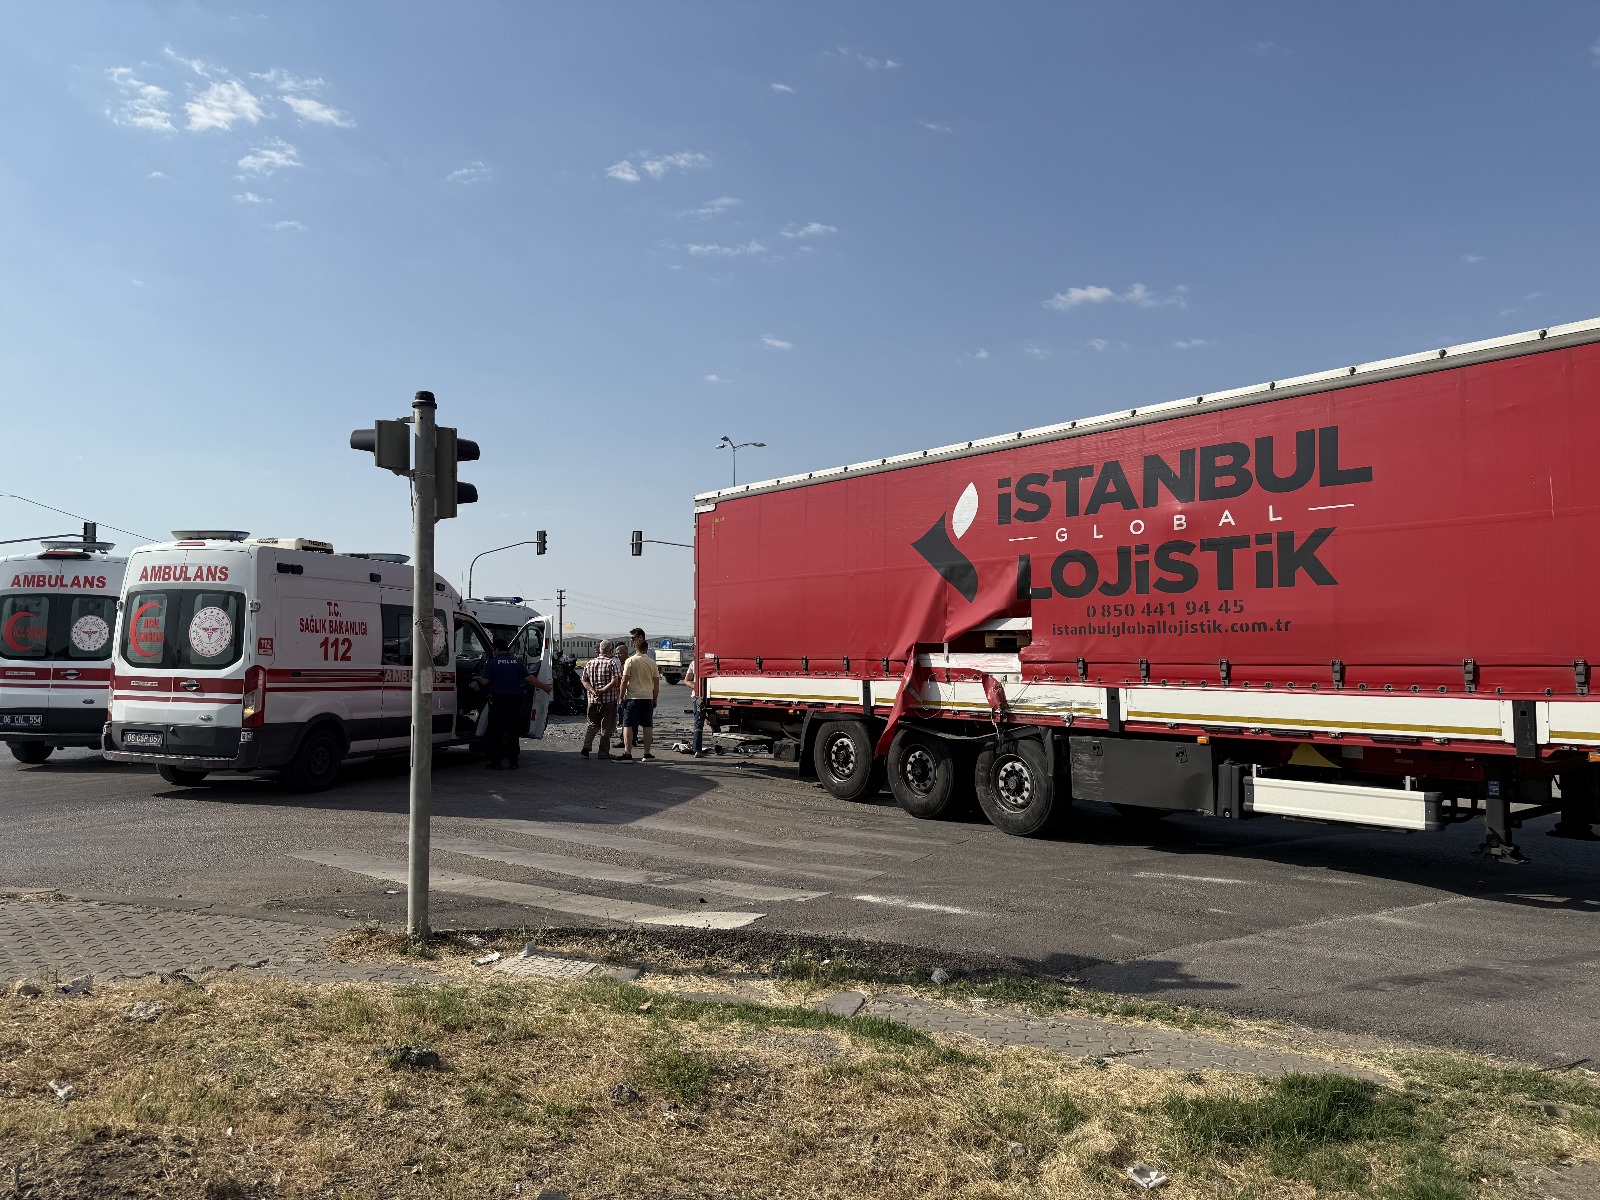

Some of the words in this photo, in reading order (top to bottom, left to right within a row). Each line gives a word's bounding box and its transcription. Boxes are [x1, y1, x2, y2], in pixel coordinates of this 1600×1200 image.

[1056, 505, 1282, 542] GLOBAL
[10, 574, 107, 589] AMBULANS
[138, 565, 229, 582] AMBULANS
[326, 601, 342, 617] T.C.
[1101, 603, 1135, 618] 850
[1141, 601, 1176, 617] 441
[1185, 600, 1210, 616] 94
[1217, 599, 1245, 614] 45
[299, 615, 327, 633] SAĞLIK
[1052, 619, 1292, 638] istanbulgloballojistik.com.tr
[260, 639, 272, 649] 112
[320, 637, 353, 661] 112
